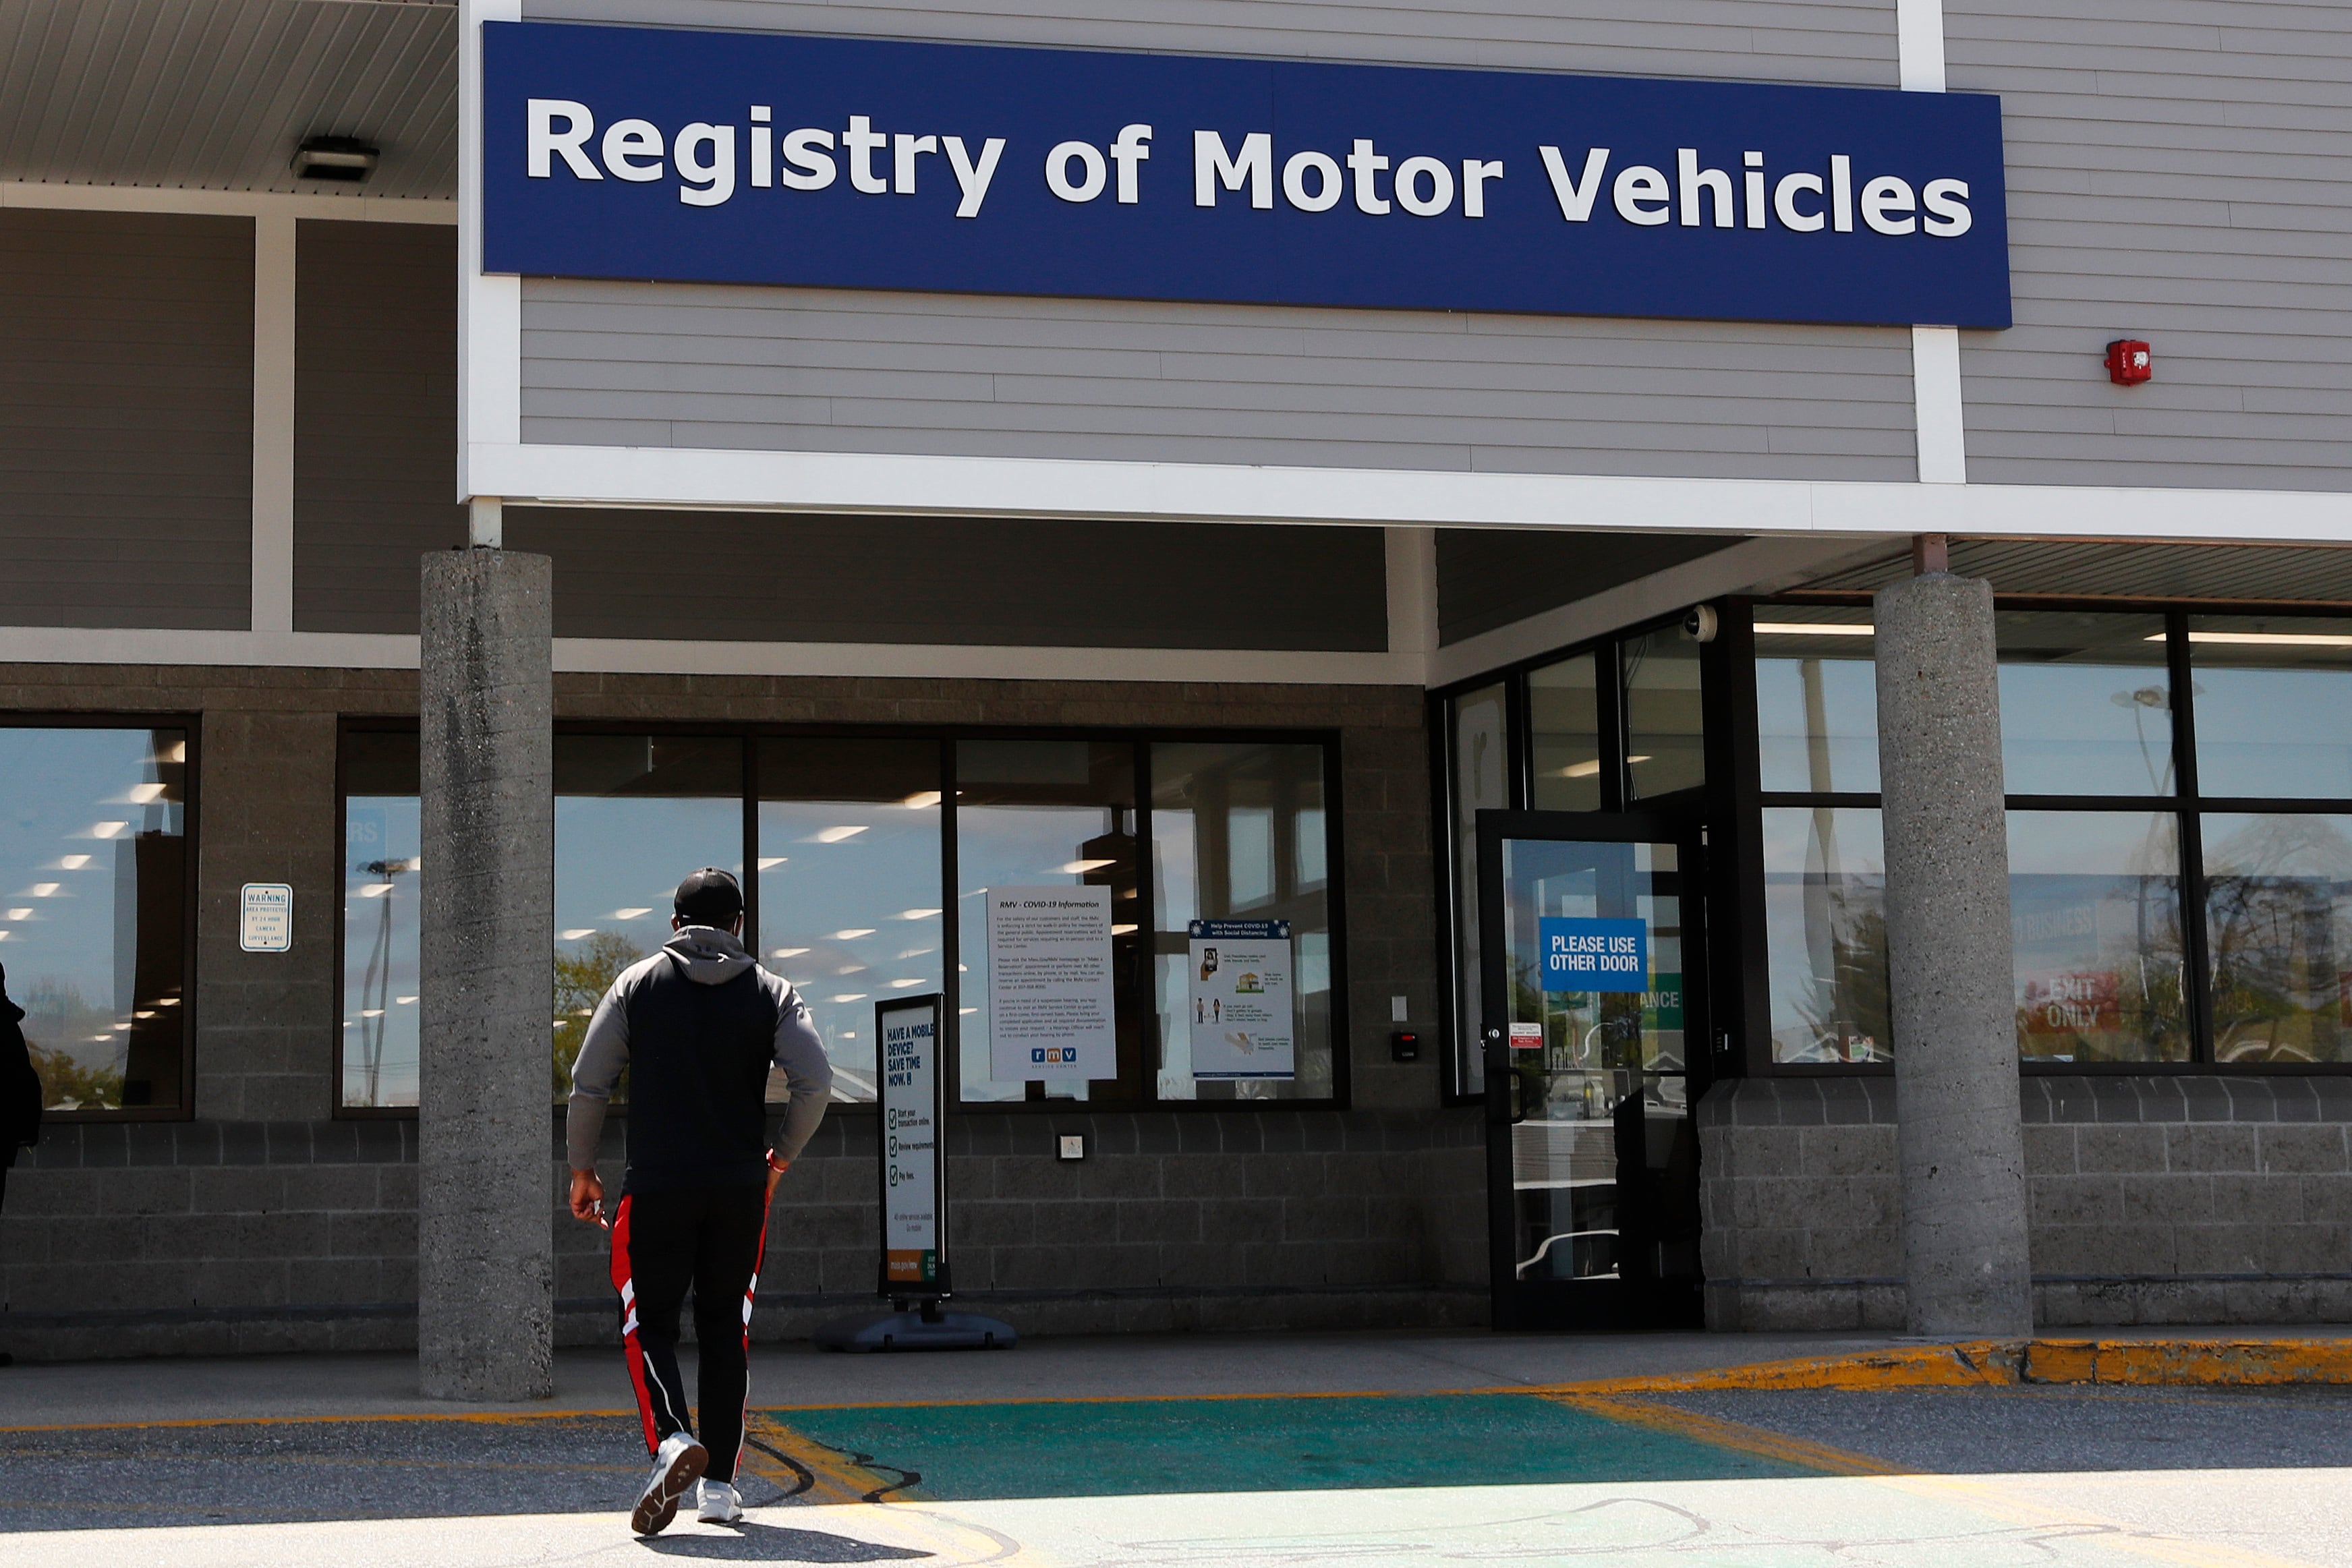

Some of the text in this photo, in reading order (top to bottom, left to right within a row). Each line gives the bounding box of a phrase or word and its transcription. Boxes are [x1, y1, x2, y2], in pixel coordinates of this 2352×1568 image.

[526, 98, 1973, 237] Registry of Motor Vehicles
[248, 894, 286, 902] WARNING
[1023, 900, 1057, 908] COVID-19
[1058, 900, 1099, 909] Information
[1552, 935, 1636, 953] PLEASE USE
[1550, 954, 1638, 972] OTHER DOOR
[2049, 978, 2094, 1000] EXIT
[2047, 1004, 2100, 1027] ONLY
[887, 1023, 934, 1041] HAVE A MOBILE
[888, 1041, 913, 1057] DEVICE?
[1035, 1049, 1074, 1061] rmv
[888, 1055, 921, 1072] SAVE TIME
[888, 1072, 906, 1087] NOW.
[907, 1109, 916, 1118] your
[898, 1119, 918, 1127] transaction
[898, 1142, 911, 1151] Review
